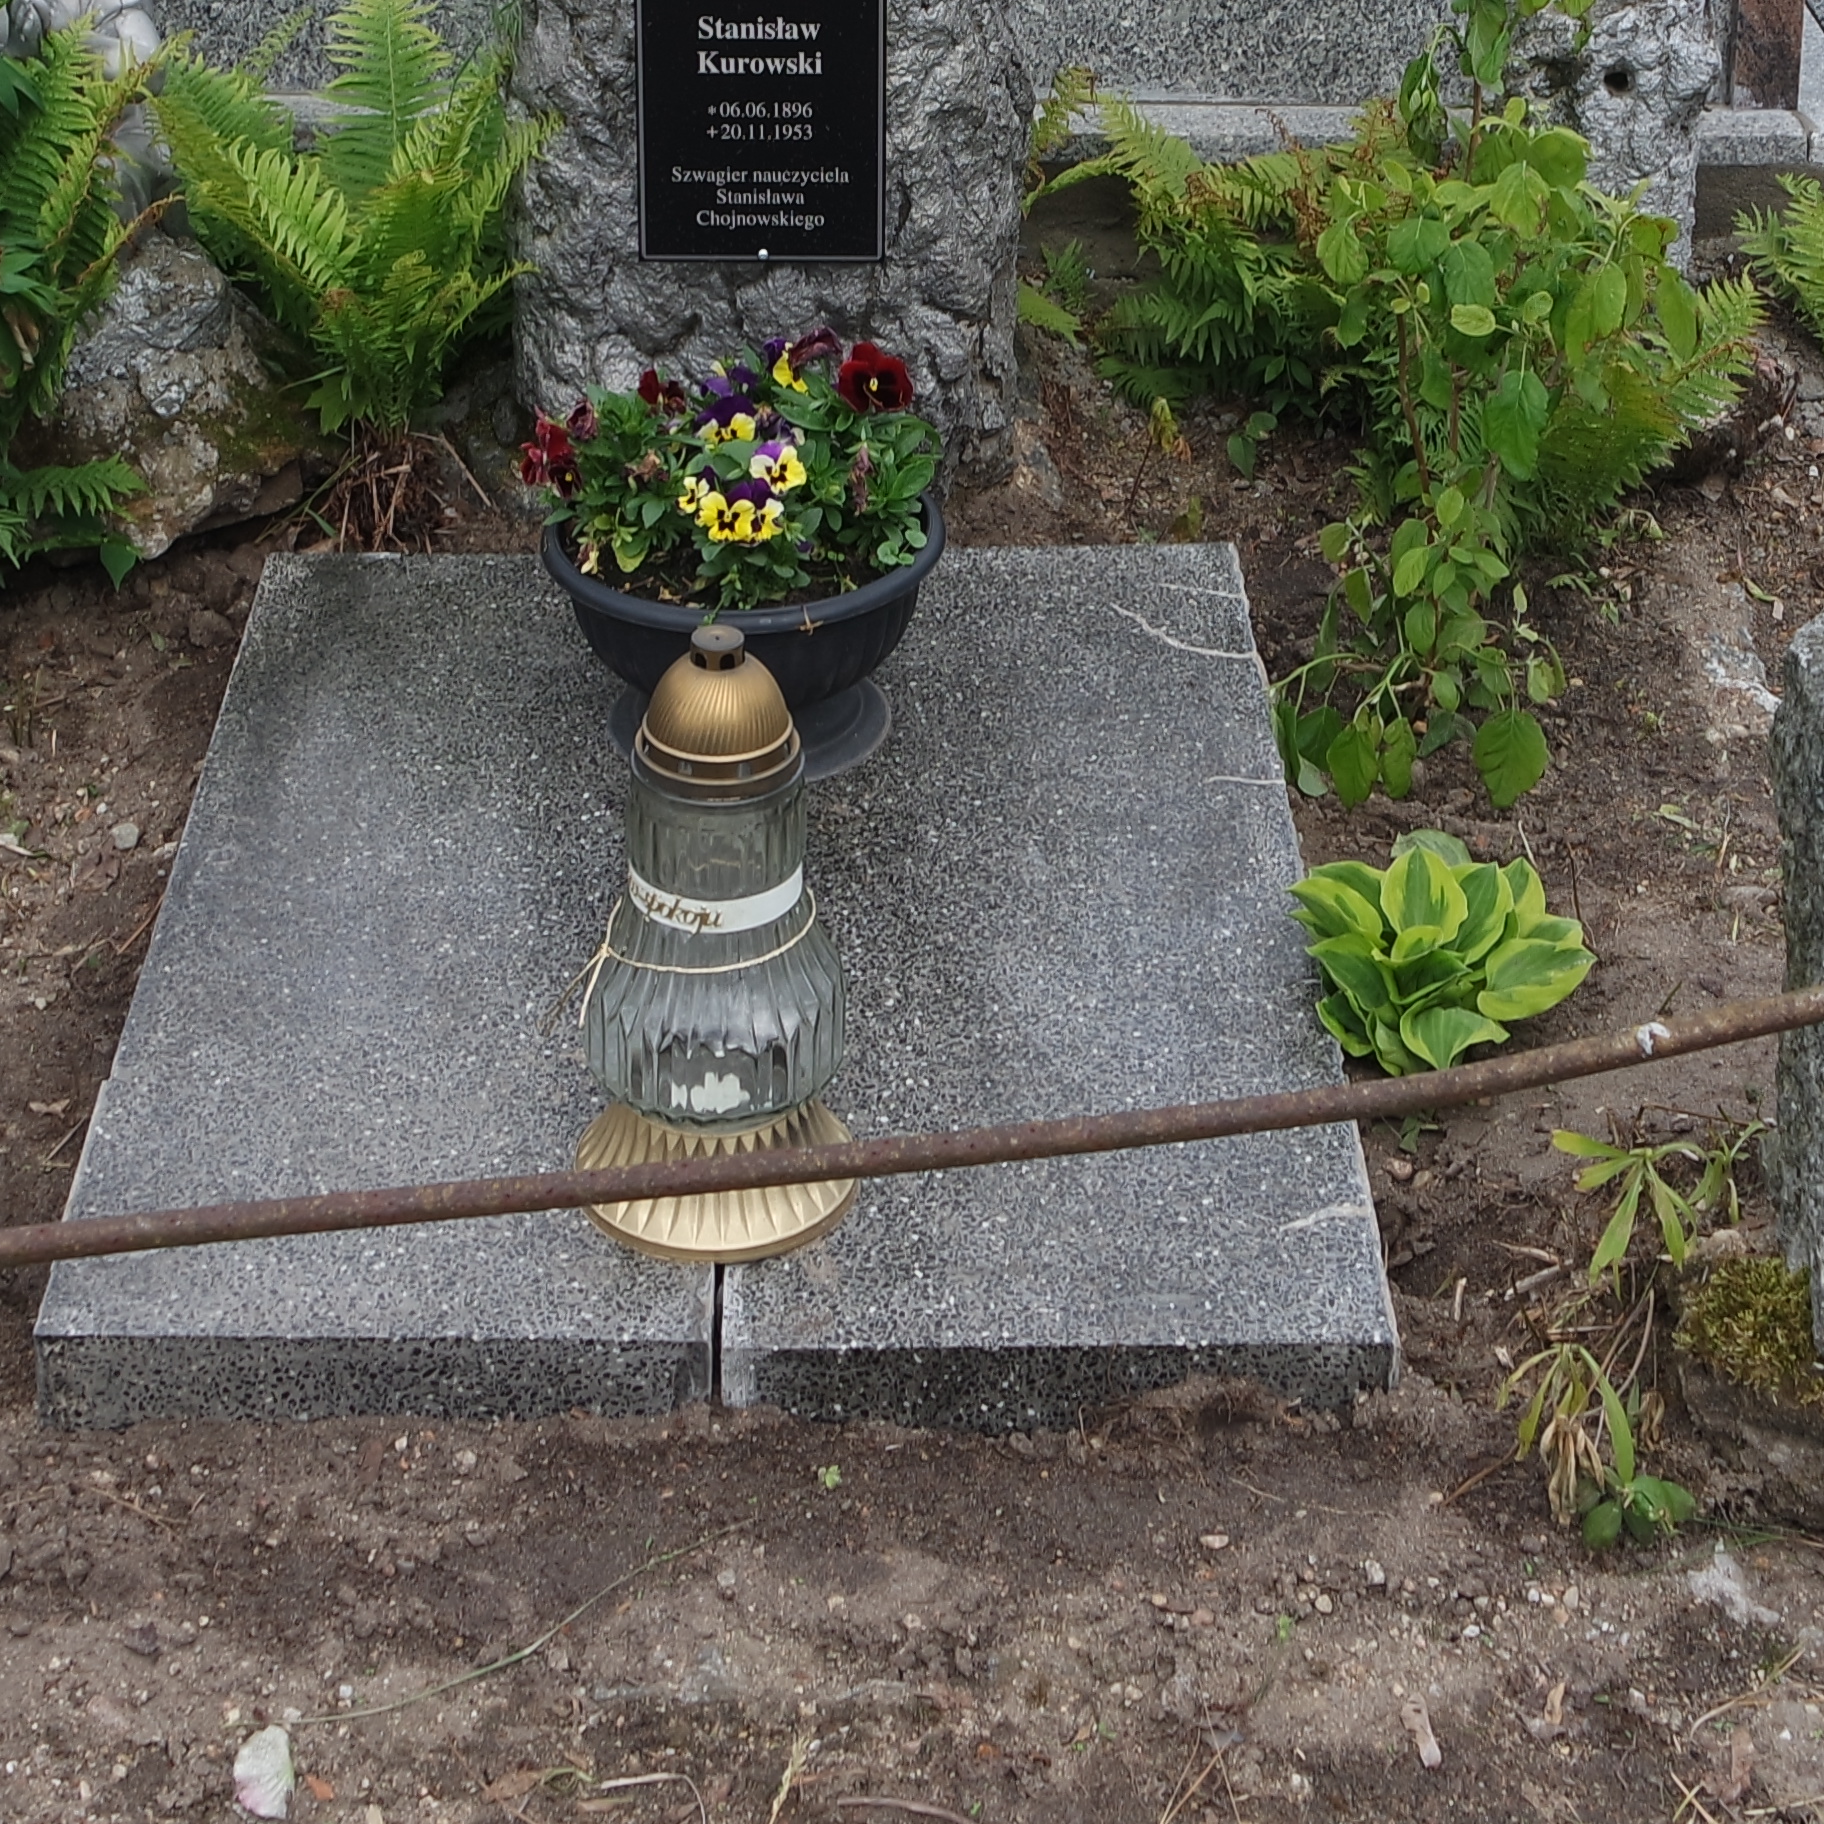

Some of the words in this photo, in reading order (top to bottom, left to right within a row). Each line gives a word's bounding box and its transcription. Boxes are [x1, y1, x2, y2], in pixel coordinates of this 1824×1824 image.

[697, 16, 822, 41] Stanisław
[697, 51, 824, 75] Kurowski
[671, 165, 749, 187] Szwagier
[752, 166, 850, 187] nauczyciela
[716, 187, 805, 206] Stanisława
[695, 209, 826, 232] Chojnowskiego
